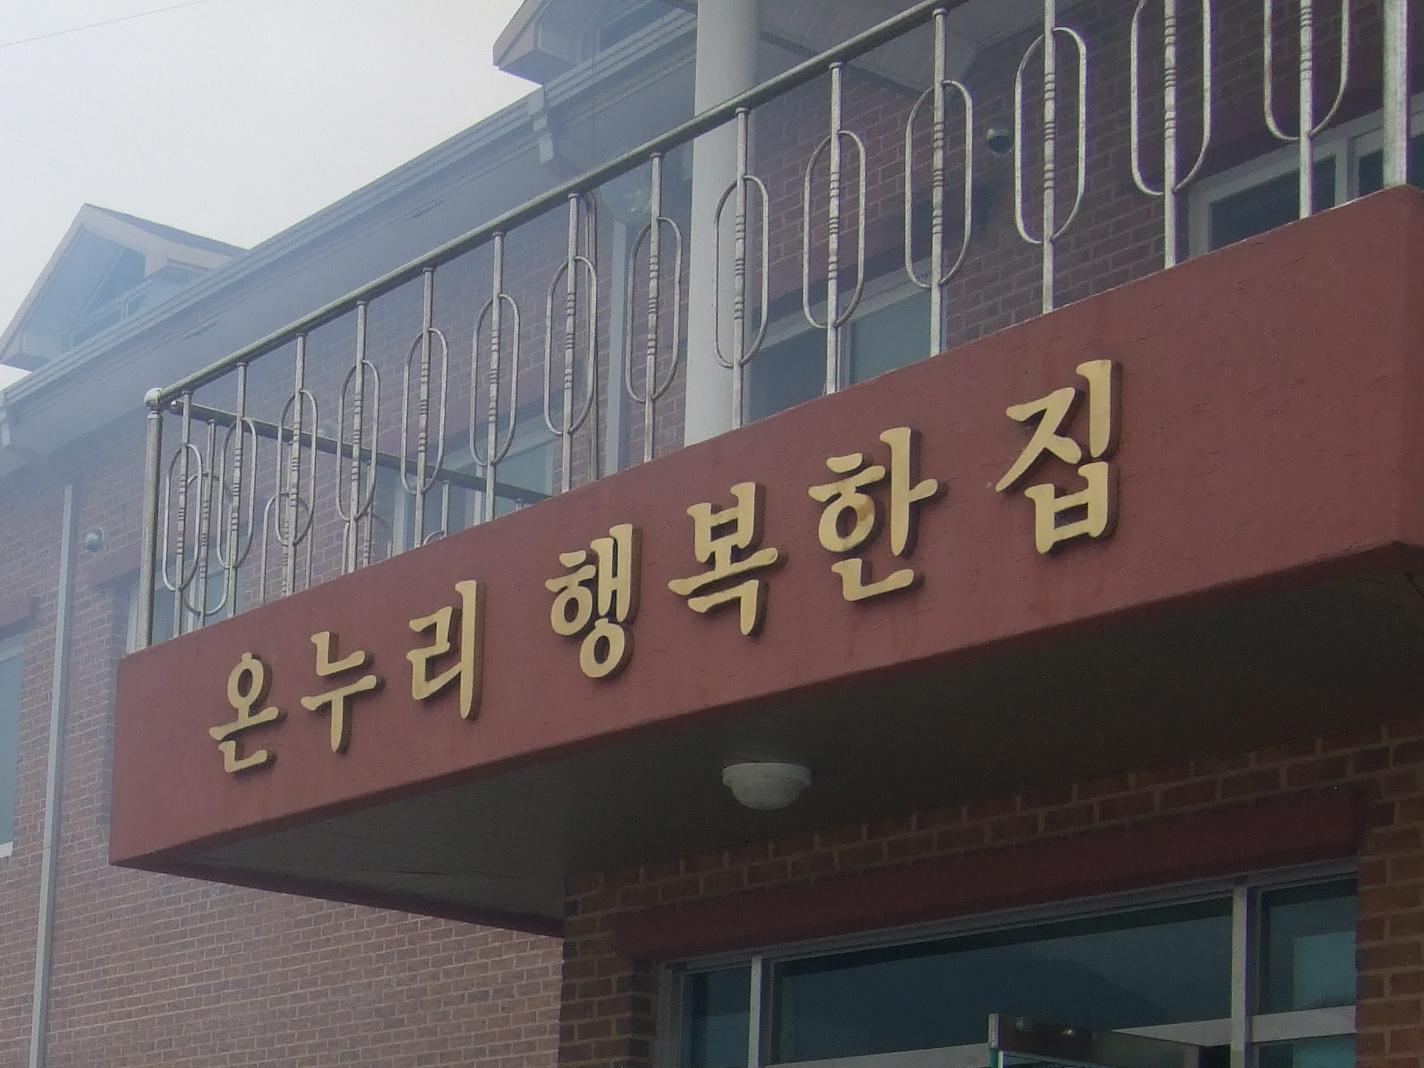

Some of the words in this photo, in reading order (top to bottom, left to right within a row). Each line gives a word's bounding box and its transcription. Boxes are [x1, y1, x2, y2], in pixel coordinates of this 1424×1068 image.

[208, 580, 481, 775] 온누리
[544, 426, 942, 680] 행복한
[994, 358, 1117, 555] 집
